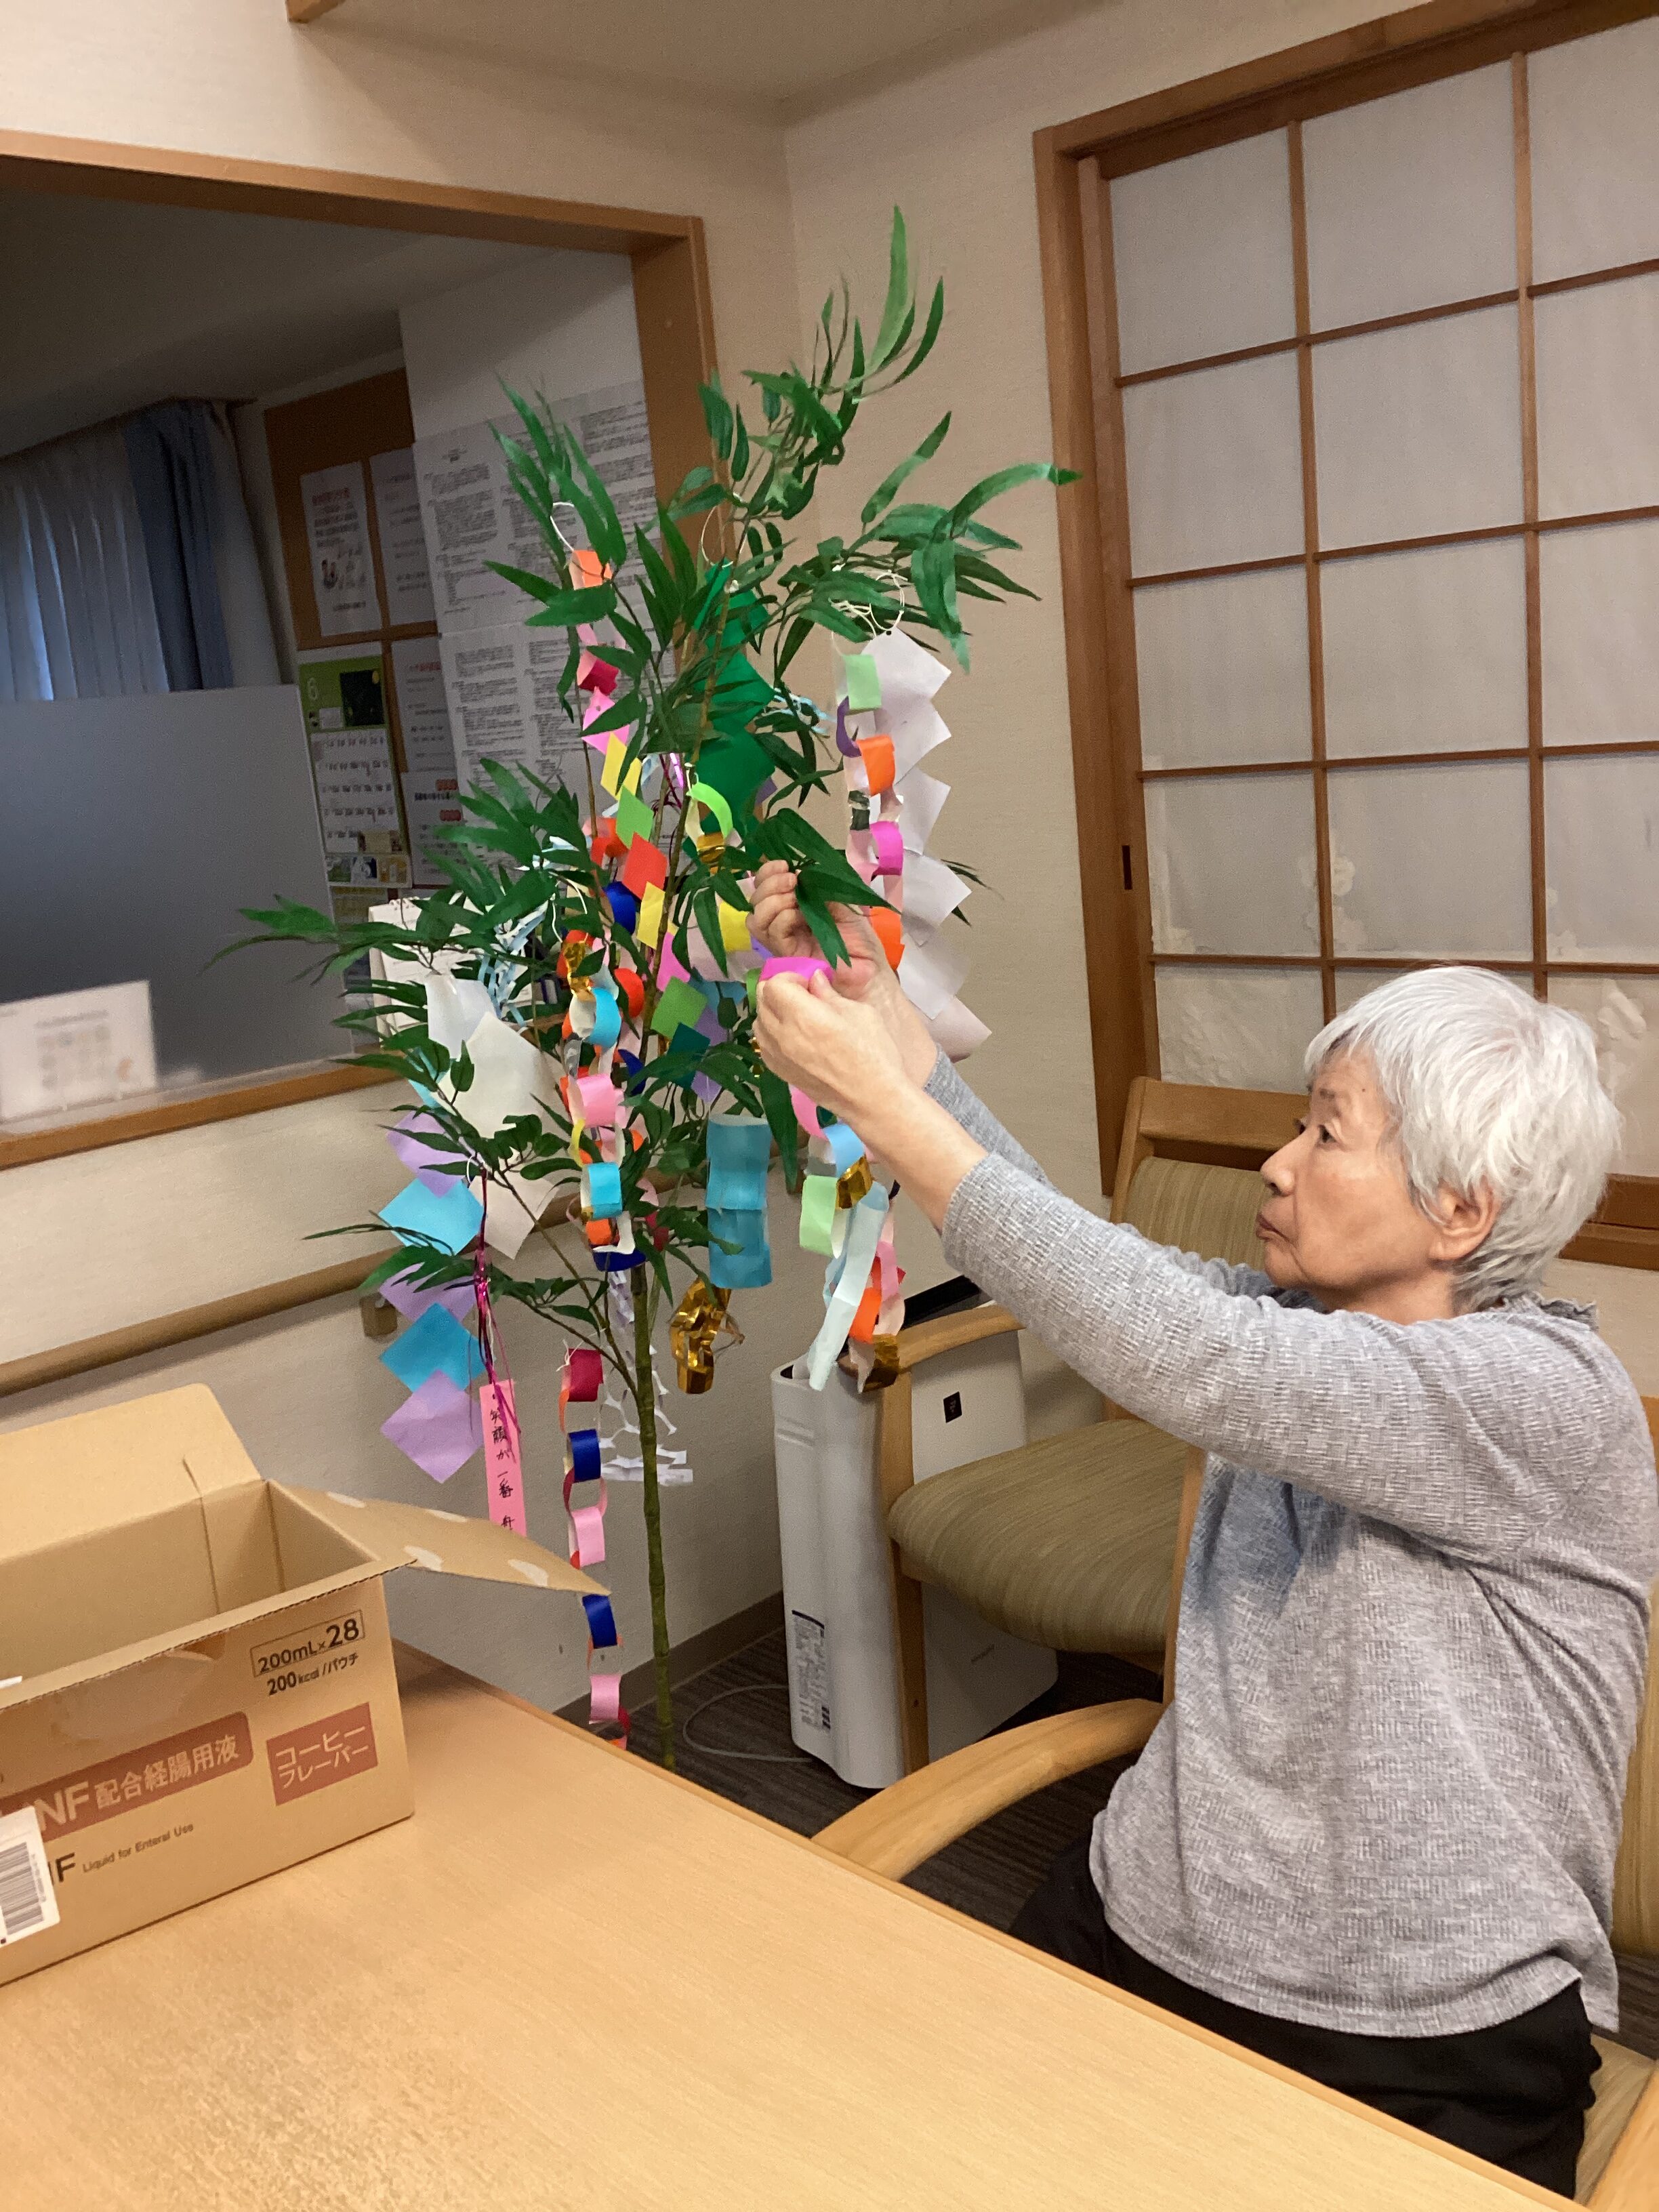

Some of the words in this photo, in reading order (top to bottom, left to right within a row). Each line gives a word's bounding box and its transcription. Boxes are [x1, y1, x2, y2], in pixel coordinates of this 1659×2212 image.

[276, 1725, 366, 1770] コーヒー
[279, 1744, 369, 1789] フレーバー
[83, 1853, 115, 1872] Liquid
[119, 1847, 131, 1859] for
[136, 1830, 170, 1852] Enteral
[174, 1824, 194, 1837] Use
